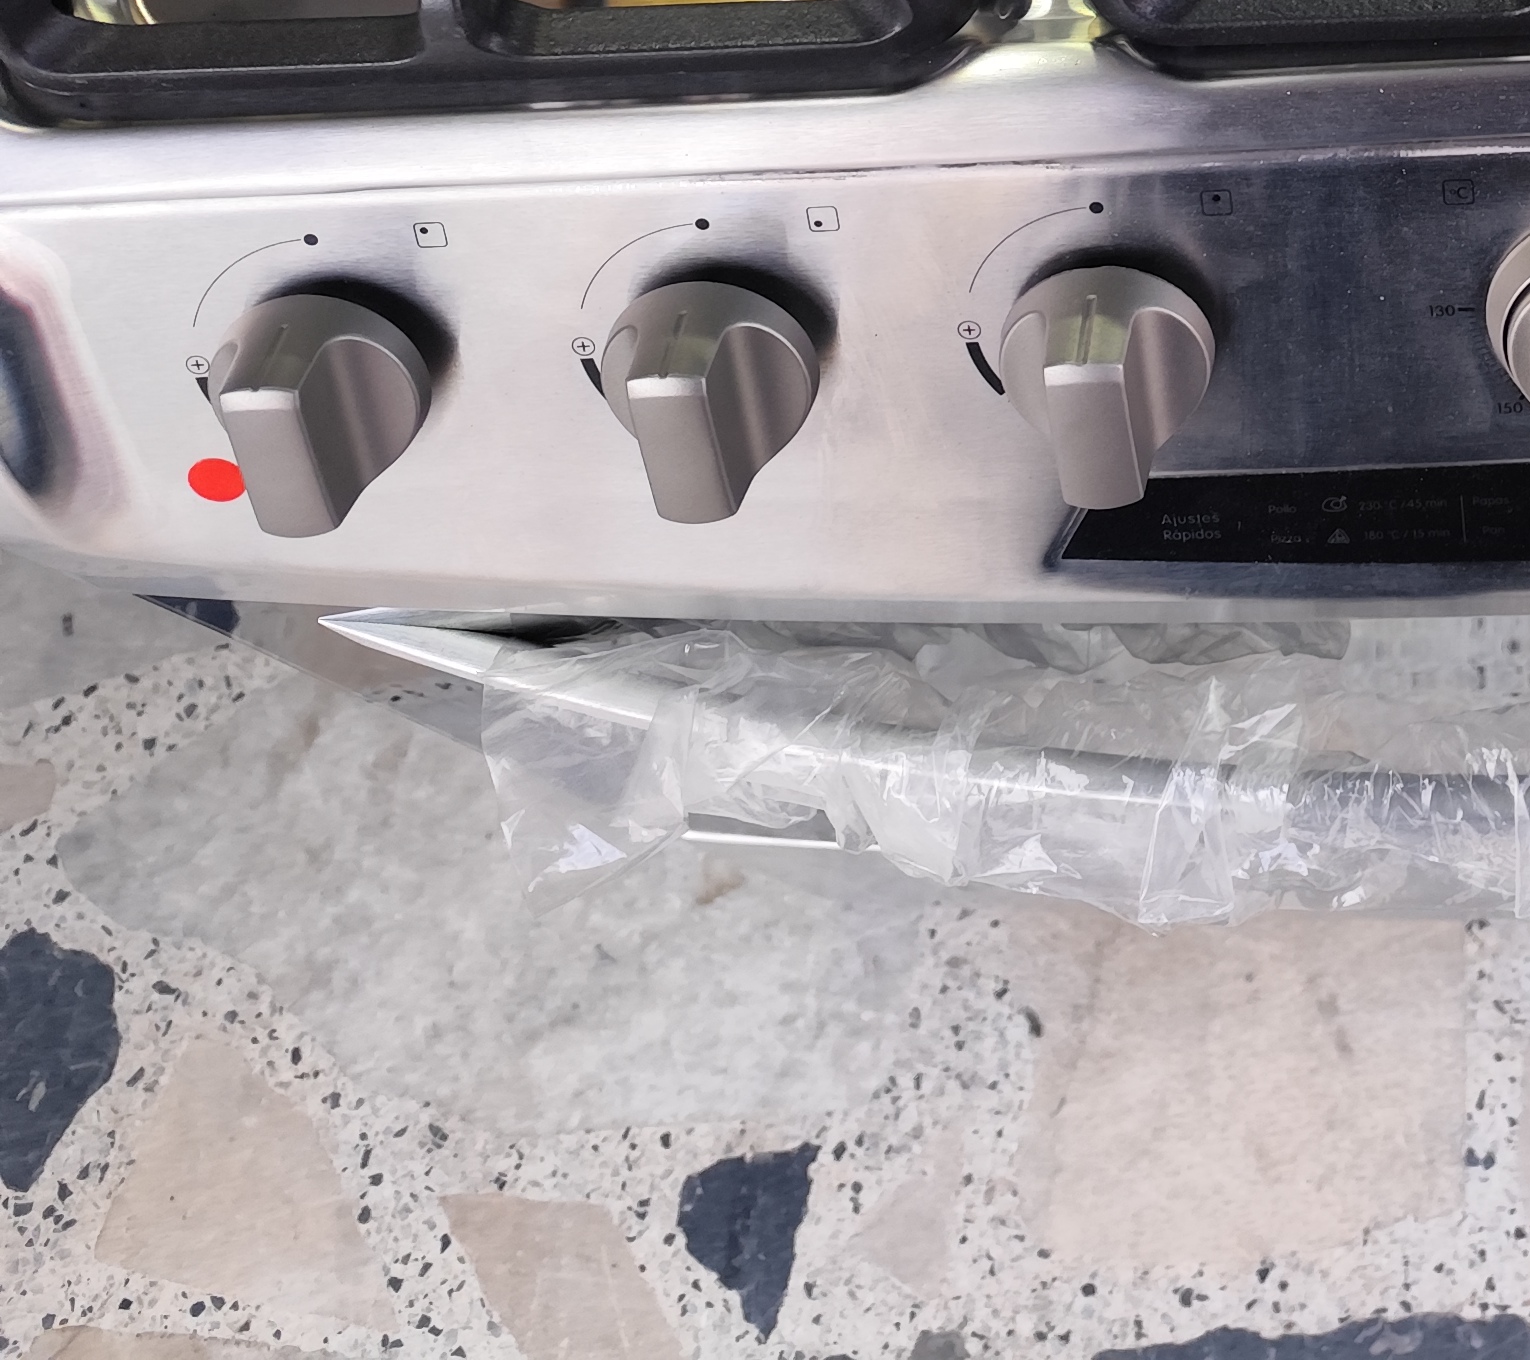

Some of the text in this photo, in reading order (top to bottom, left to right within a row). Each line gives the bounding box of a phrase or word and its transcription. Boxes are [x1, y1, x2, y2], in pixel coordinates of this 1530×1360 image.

[1428, 304, 1456, 318] 130
[1497, 401, 1524, 415] 150
[1267, 503, 1298, 516] Pollo
[1160, 511, 1221, 529] Ajustes
[1163, 528, 1222, 544] Rápidos
